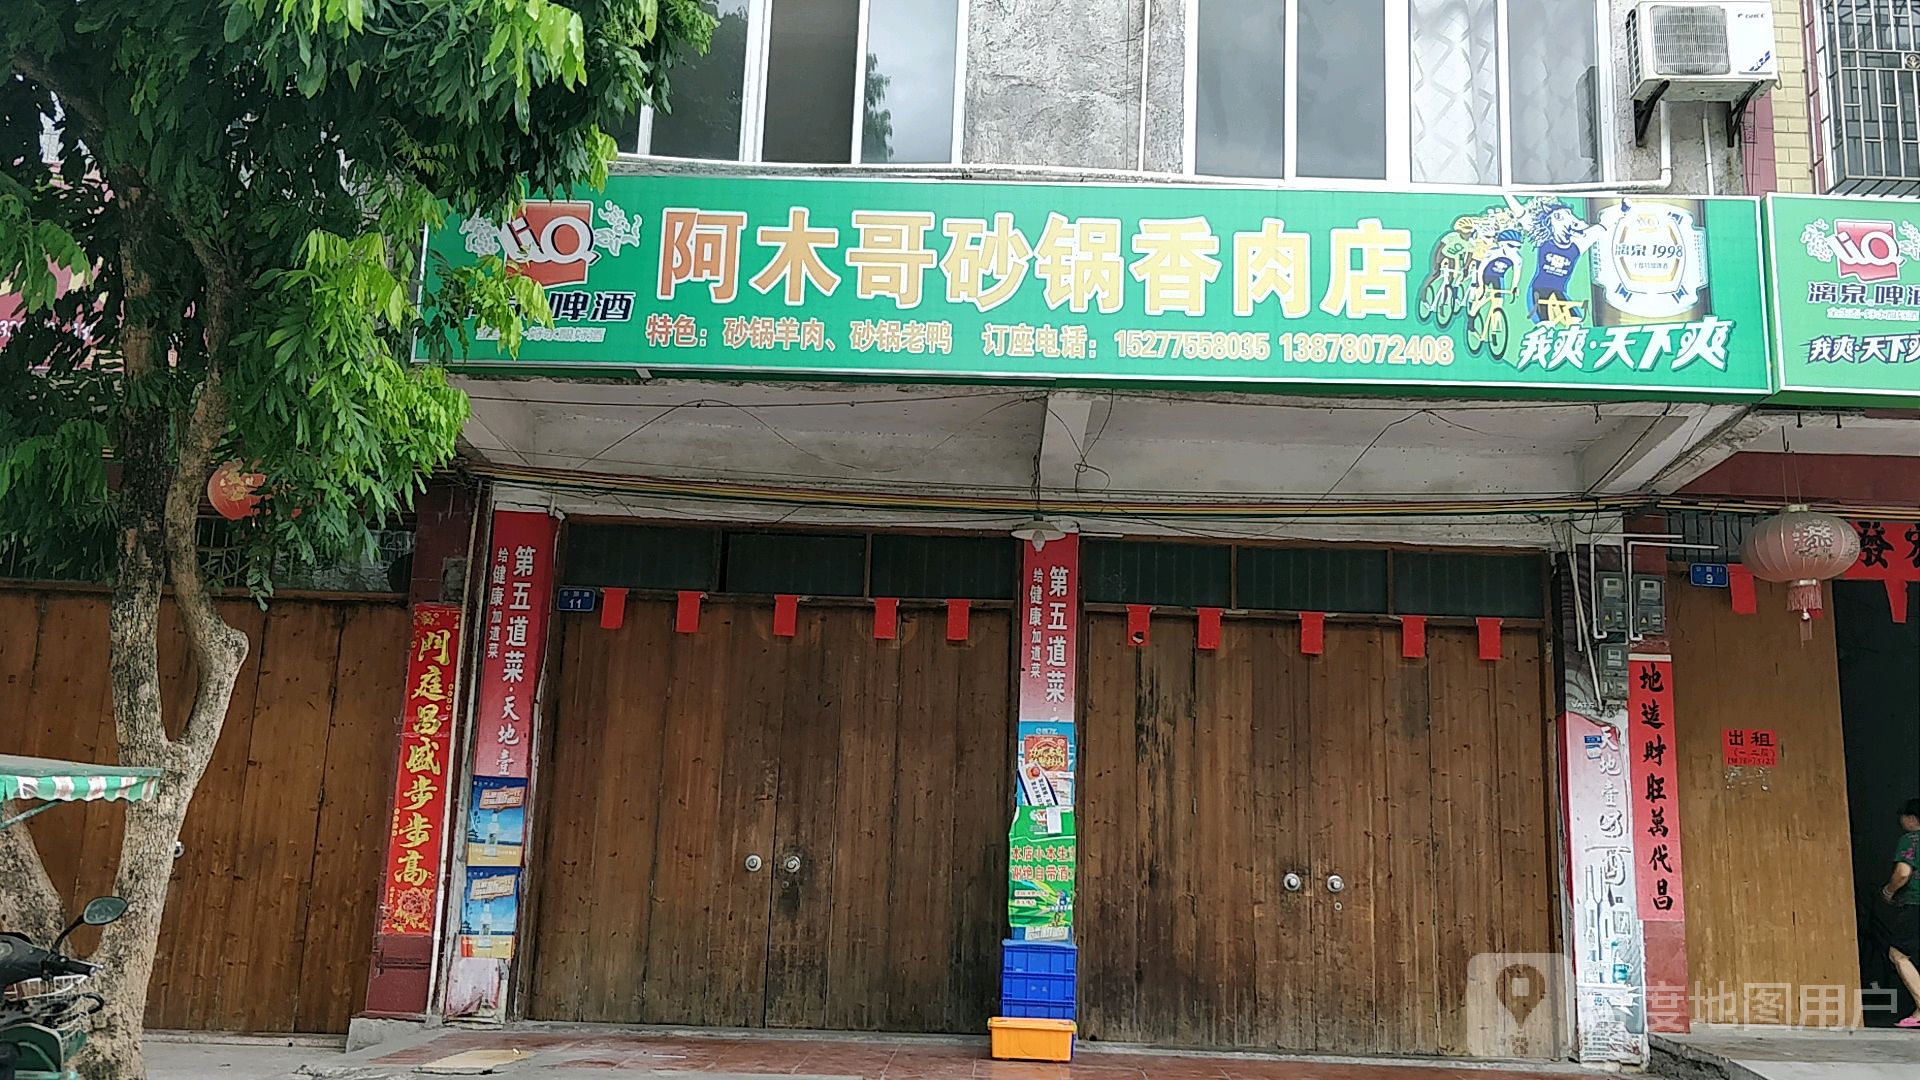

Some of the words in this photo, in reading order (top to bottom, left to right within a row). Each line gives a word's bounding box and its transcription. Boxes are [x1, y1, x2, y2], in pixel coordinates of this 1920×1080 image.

[1652, 244, 1684, 259] 1998
[656, 206, 1411, 319] 阿木哥砂锅香肉店
[1113, 328, 1271, 361] 15277558035
[1278, 331, 1456, 366] 13878072408
[1706, 574, 1714, 584] 9
[569, 598, 582, 609] 11
[1045, 566, 1070, 722] 第五道菜·
[1729, 730, 1774, 746] 出租
